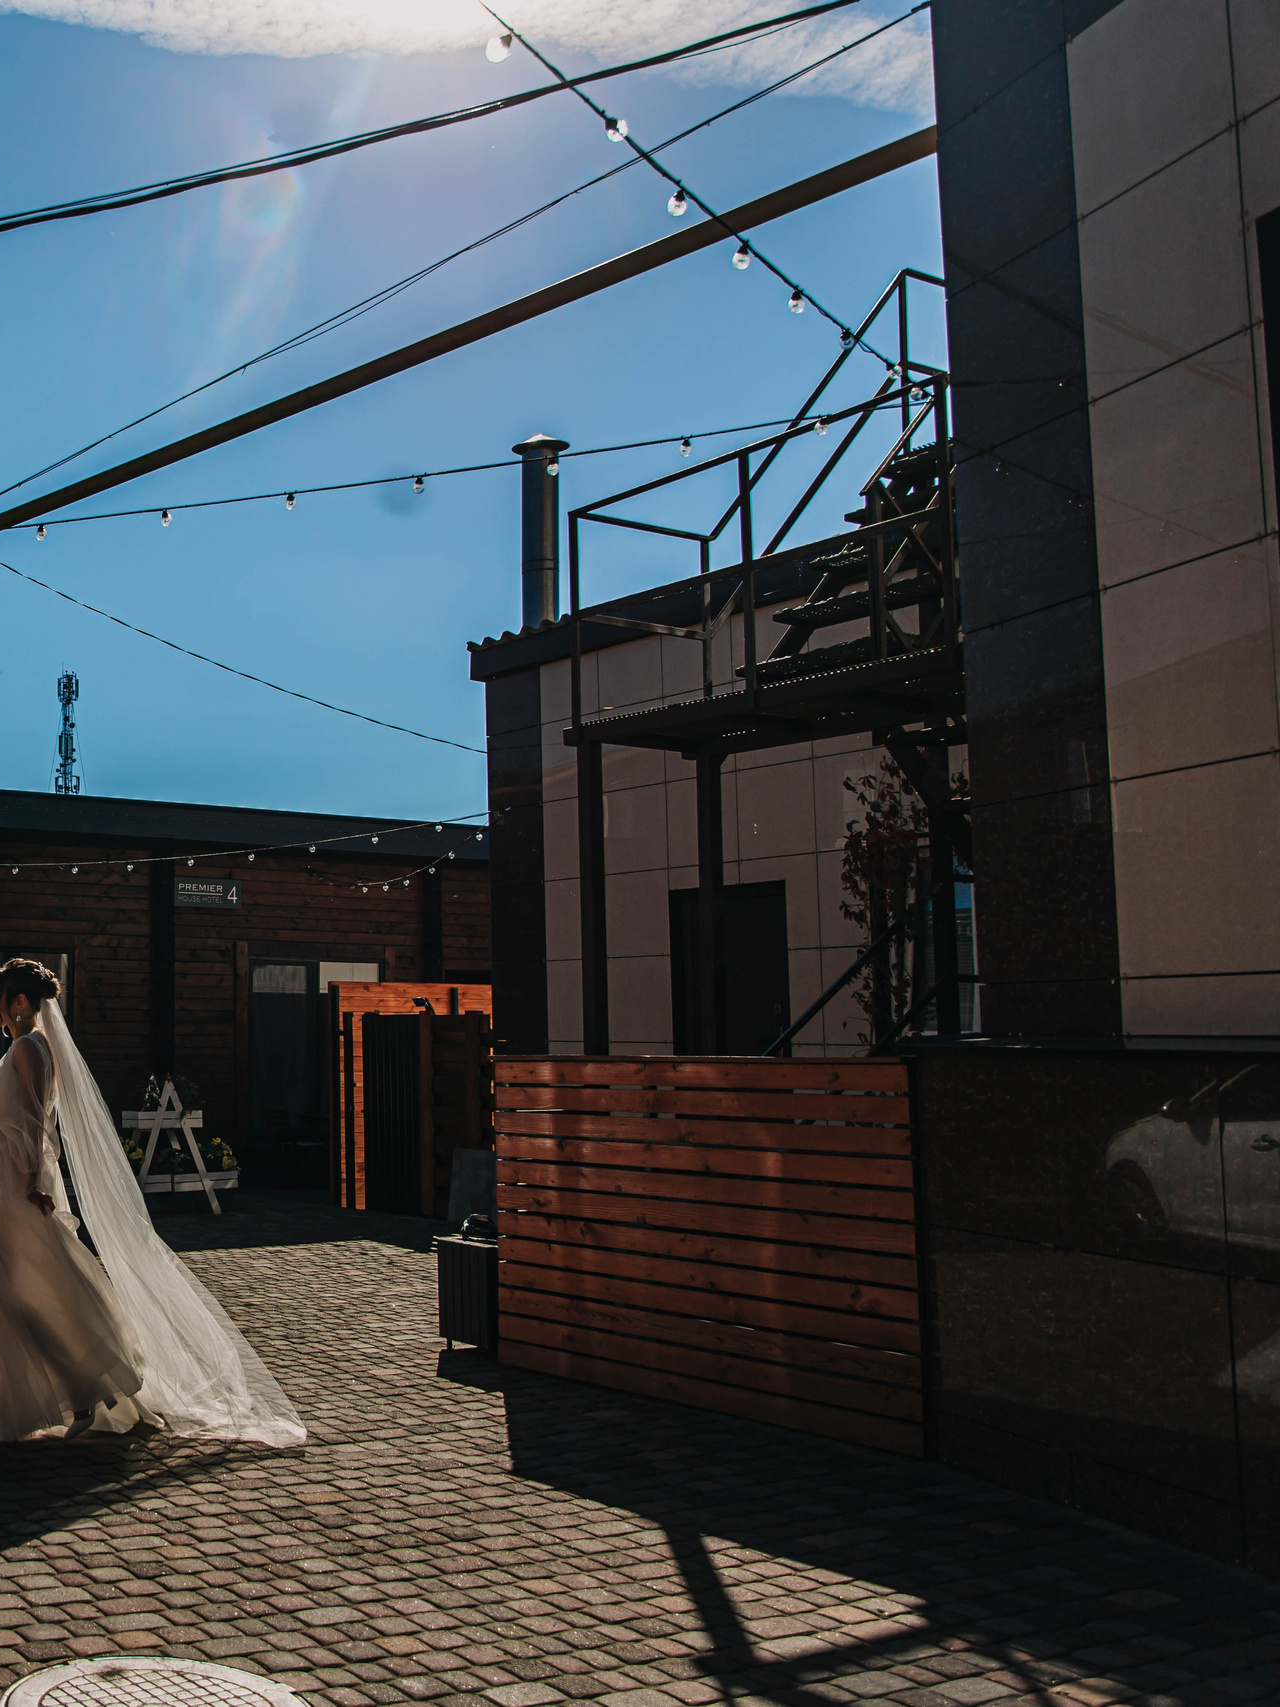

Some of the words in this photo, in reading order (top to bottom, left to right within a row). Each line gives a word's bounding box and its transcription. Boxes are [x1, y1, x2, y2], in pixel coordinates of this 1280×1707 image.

[178, 883, 223, 892] PREMIER
[227, 886, 238, 903] 4
[202, 896, 223, 904] HOTEL
